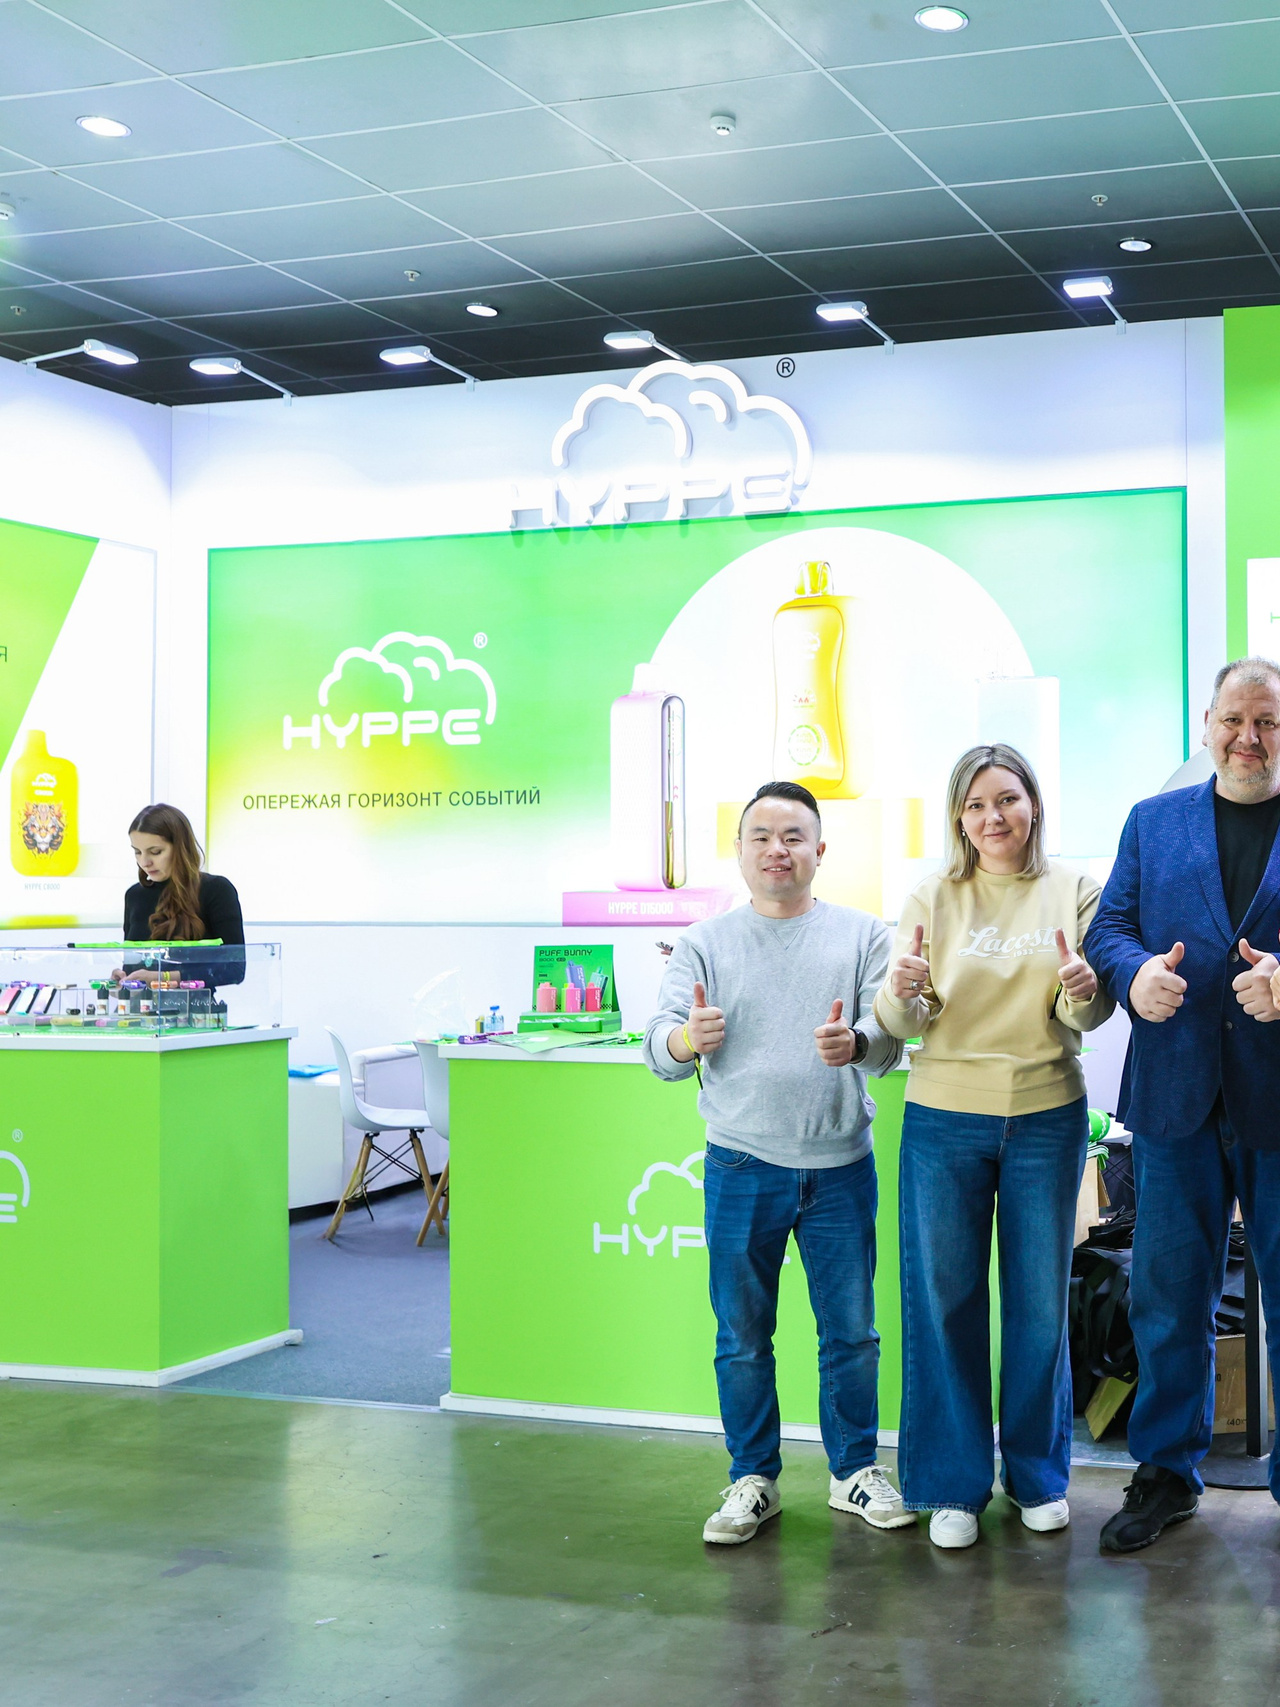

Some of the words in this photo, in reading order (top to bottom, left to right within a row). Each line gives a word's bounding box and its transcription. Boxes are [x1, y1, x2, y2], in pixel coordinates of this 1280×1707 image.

[507, 466, 793, 530] HYPPE
[283, 708, 481, 750] HYPPE
[243, 793, 341, 810] ОПЕРЕЖАЯ
[348, 791, 443, 808] ГОРИЗОНТ
[448, 786, 541, 807] СОБЫТИЙ
[608, 901, 638, 914] HYPPE
[640, 901, 674, 914] D15000
[958, 926, 1059, 957] Lacost
[1013, 948, 1034, 957] 1933
